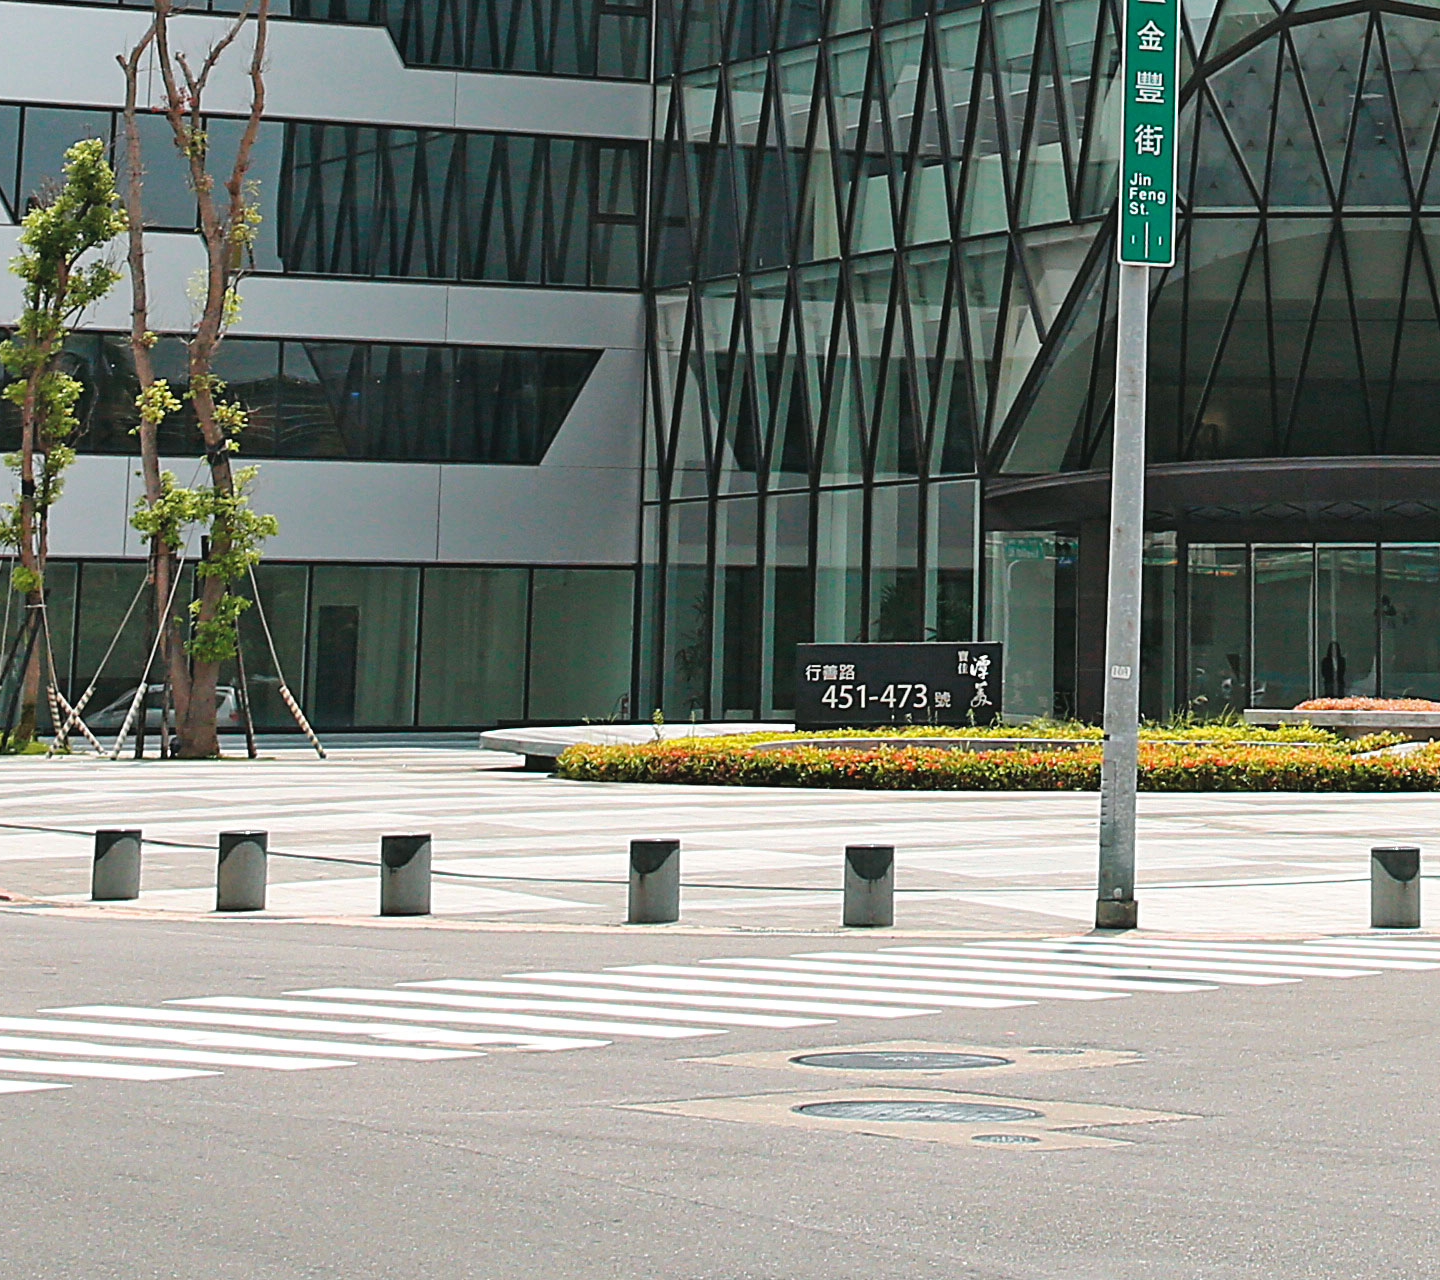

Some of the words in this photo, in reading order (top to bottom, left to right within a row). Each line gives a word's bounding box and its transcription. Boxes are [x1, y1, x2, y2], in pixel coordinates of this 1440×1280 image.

[1134, 20, 1166, 156] 金豐街
[1129, 172, 1152, 186] Jin
[1129, 187, 1166, 205] Feng
[1129, 201, 1149, 215] St.
[805, 664, 856, 681] 行善路
[821, 683, 927, 709] 451-473
